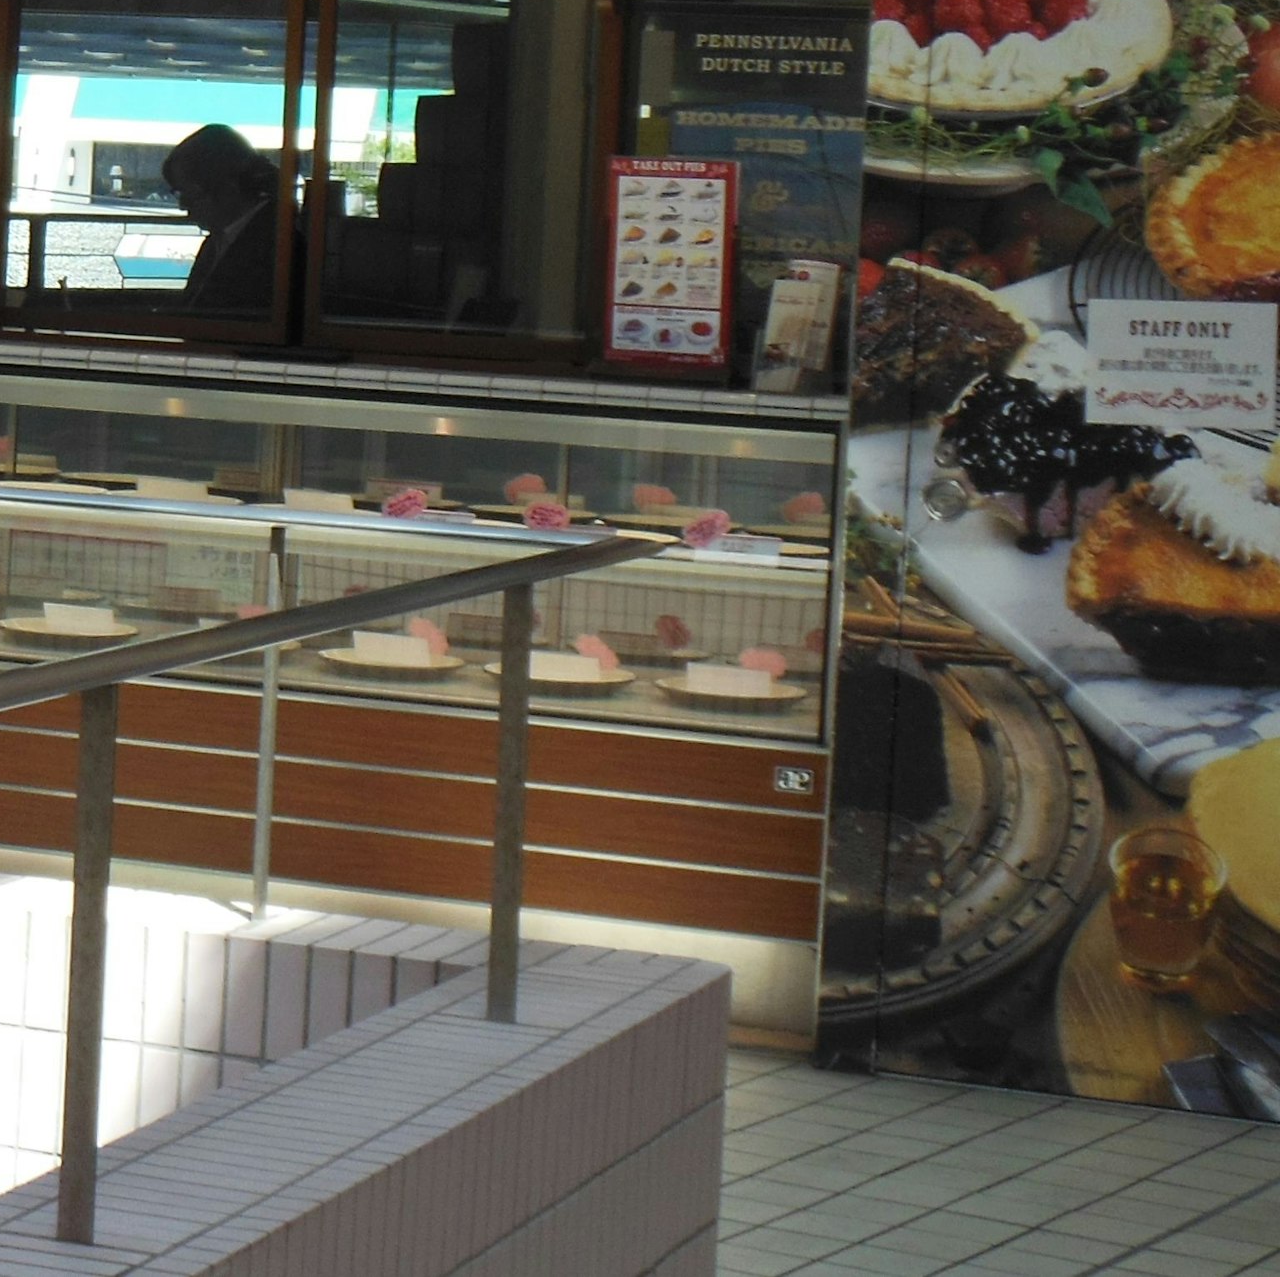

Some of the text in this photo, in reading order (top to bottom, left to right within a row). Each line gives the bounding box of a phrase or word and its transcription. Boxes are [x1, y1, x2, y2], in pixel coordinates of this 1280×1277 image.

[695, 33, 853, 53] PENNSYLVANIA
[701, 57, 845, 77] DUTCH STYLE
[676, 110, 867, 132] HOMEMADE
[735, 137, 809, 156] PIES
[632, 160, 660, 171] TAKE
[661, 161, 683, 172] OUT
[1128, 319, 1234, 340] STAFF ONLY
